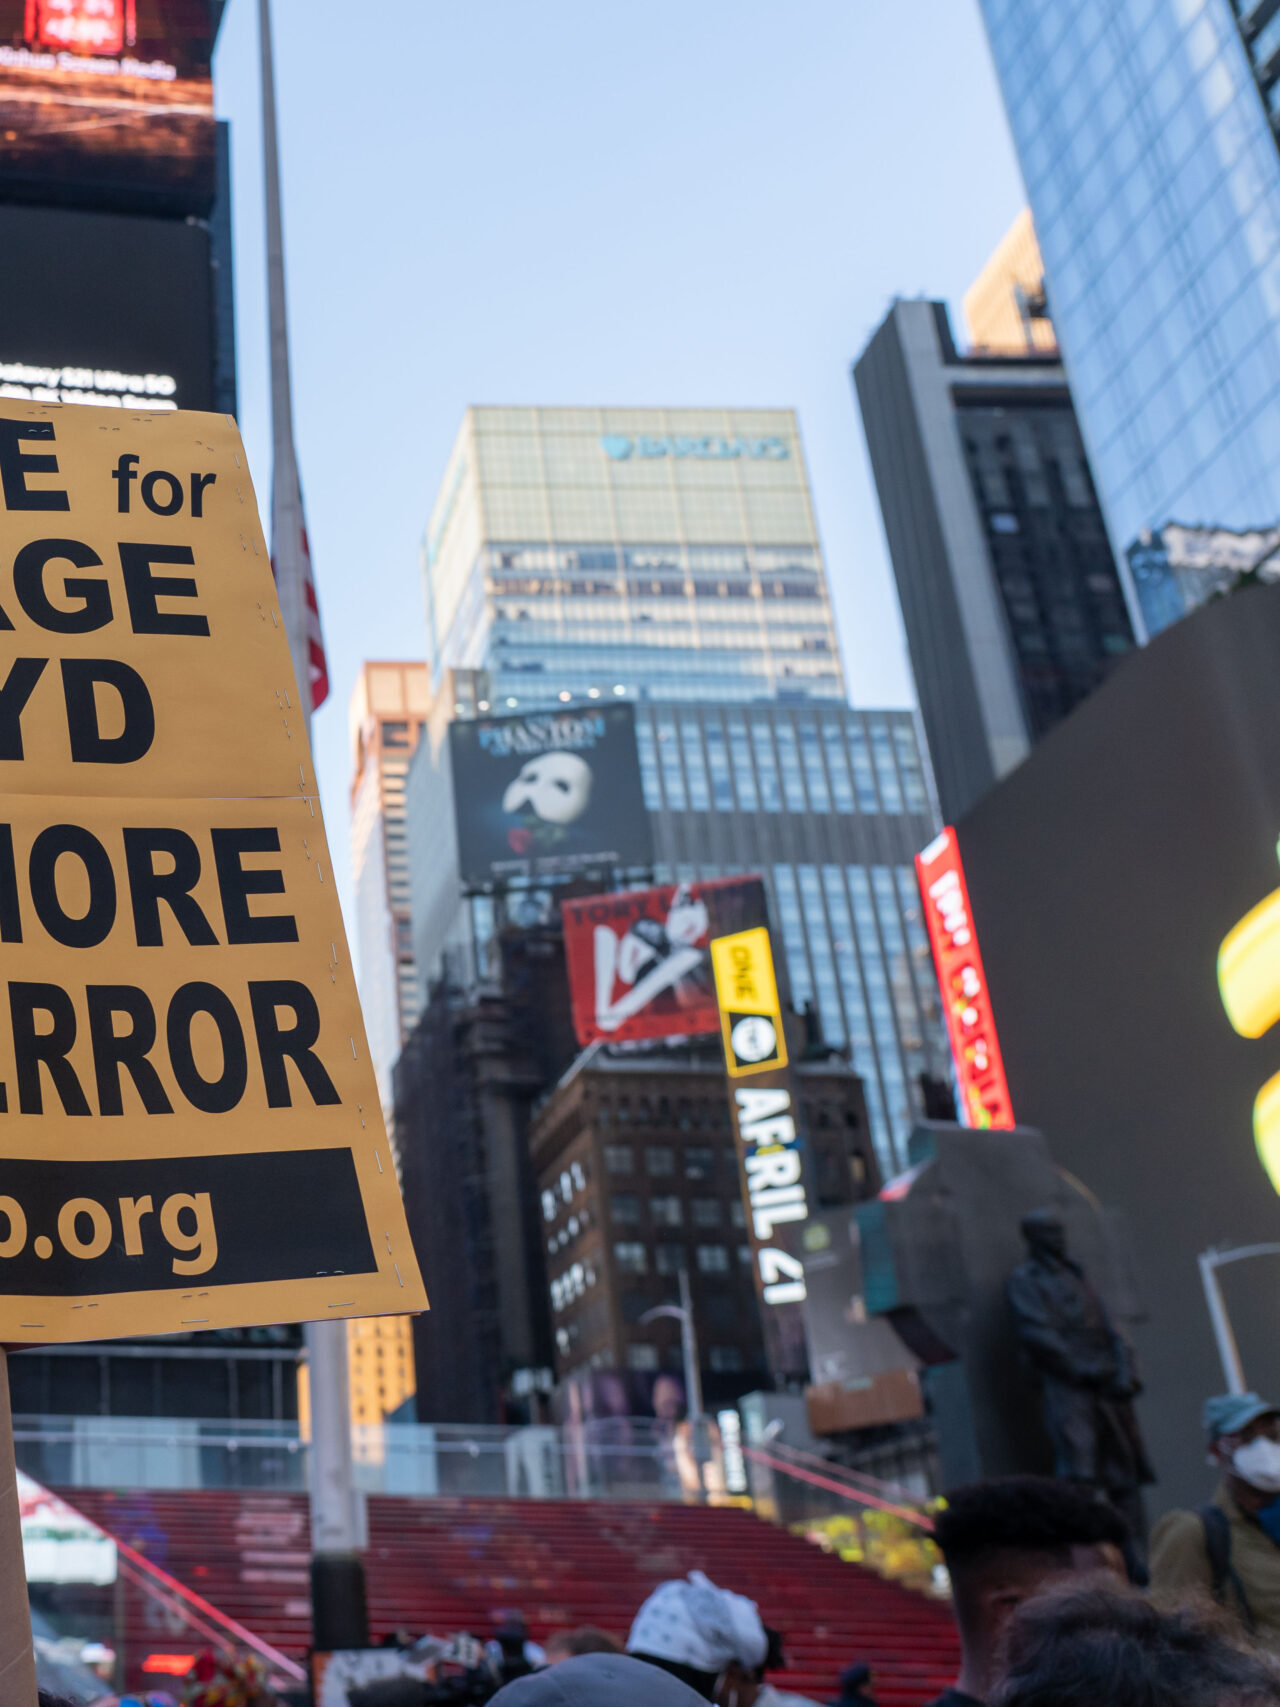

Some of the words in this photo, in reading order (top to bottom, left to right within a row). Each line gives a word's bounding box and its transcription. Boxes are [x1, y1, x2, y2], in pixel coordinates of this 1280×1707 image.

[637, 433, 791, 461] BARCLAYS
[112, 454, 217, 519] for
[735, 1087, 808, 1241] APRIL
